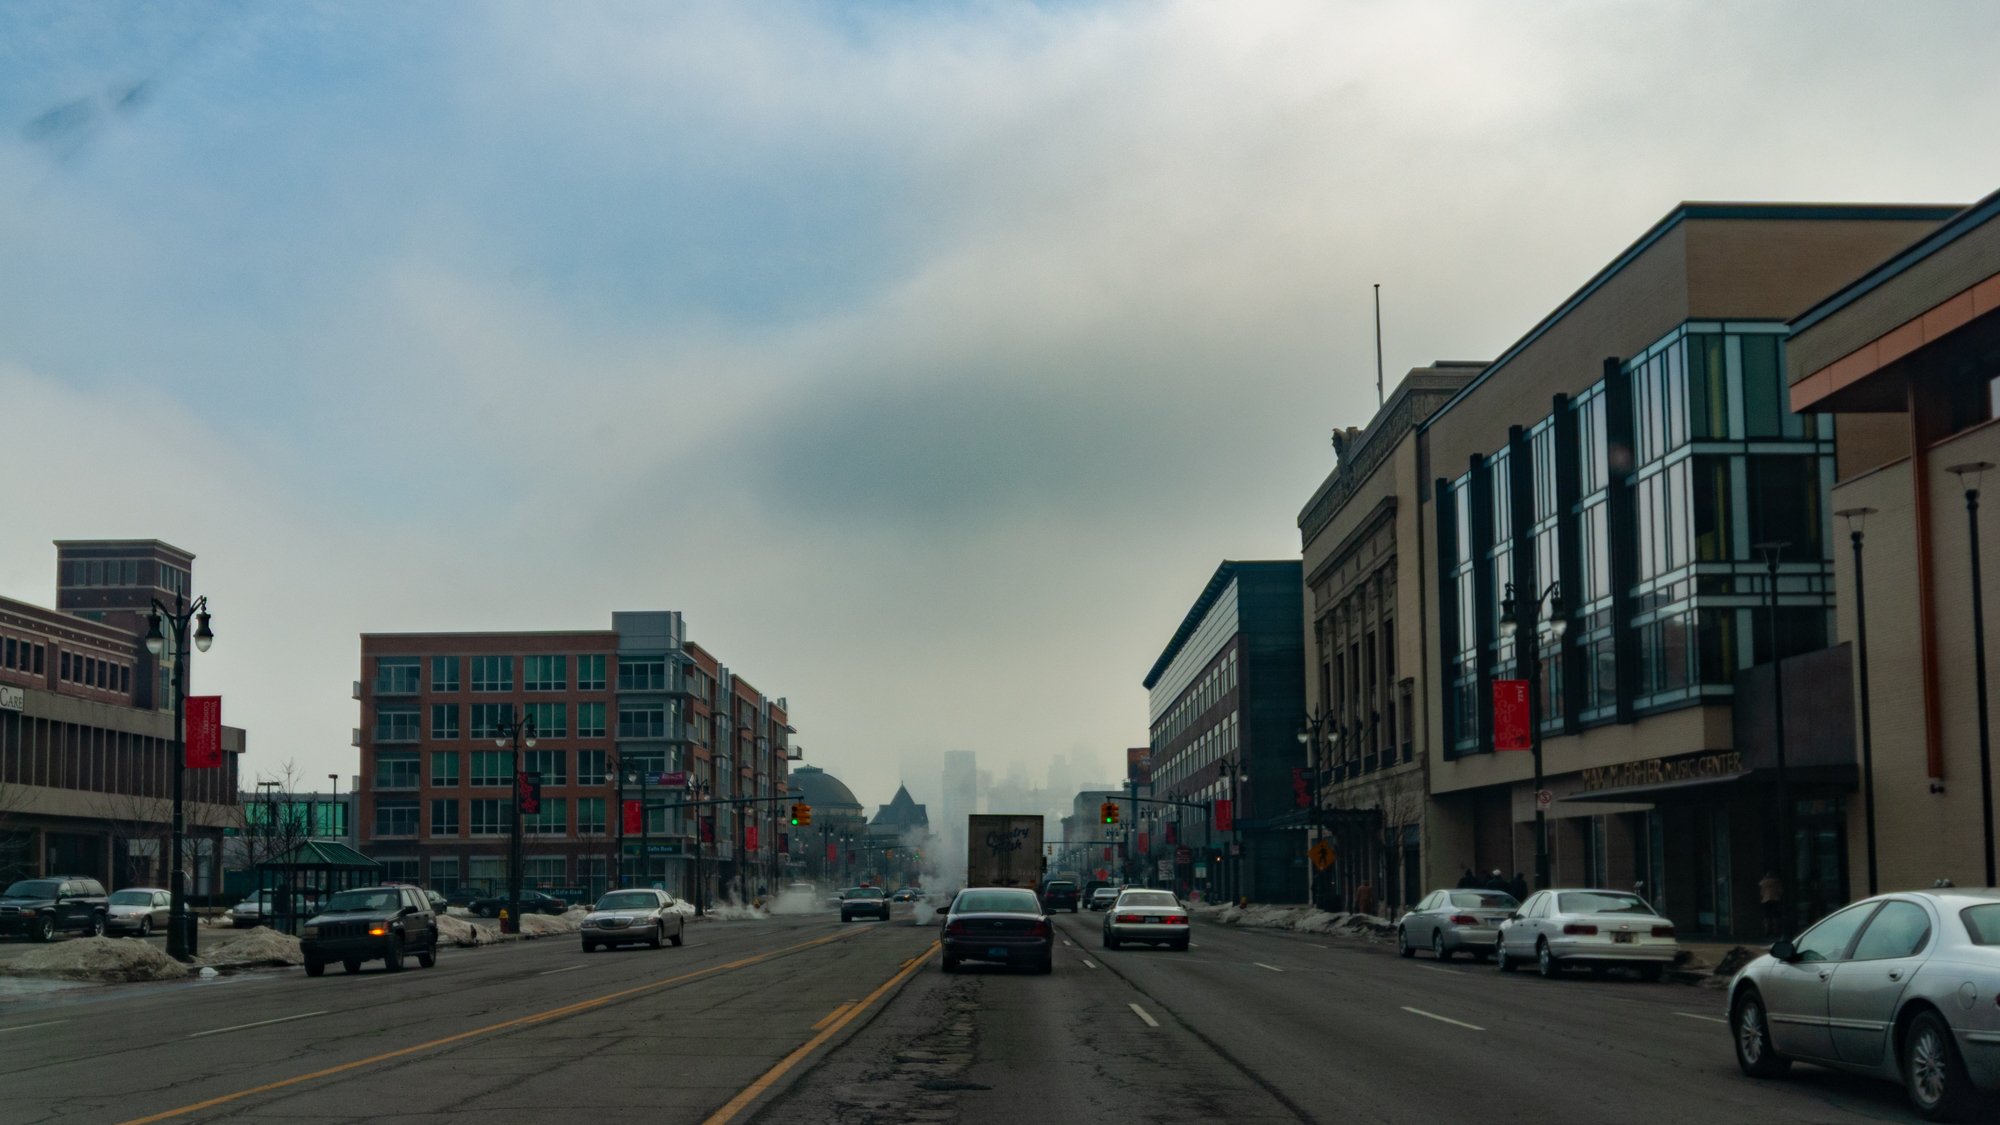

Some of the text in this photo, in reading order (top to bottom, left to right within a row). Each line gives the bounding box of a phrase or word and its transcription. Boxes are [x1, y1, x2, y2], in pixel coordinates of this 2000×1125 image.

[1582, 767, 1605, 792] MAX
[1623, 758, 1664, 786] FISHER
[1664, 758, 1697, 781] MUSIC
[1698, 752, 1743, 776] CENTER
